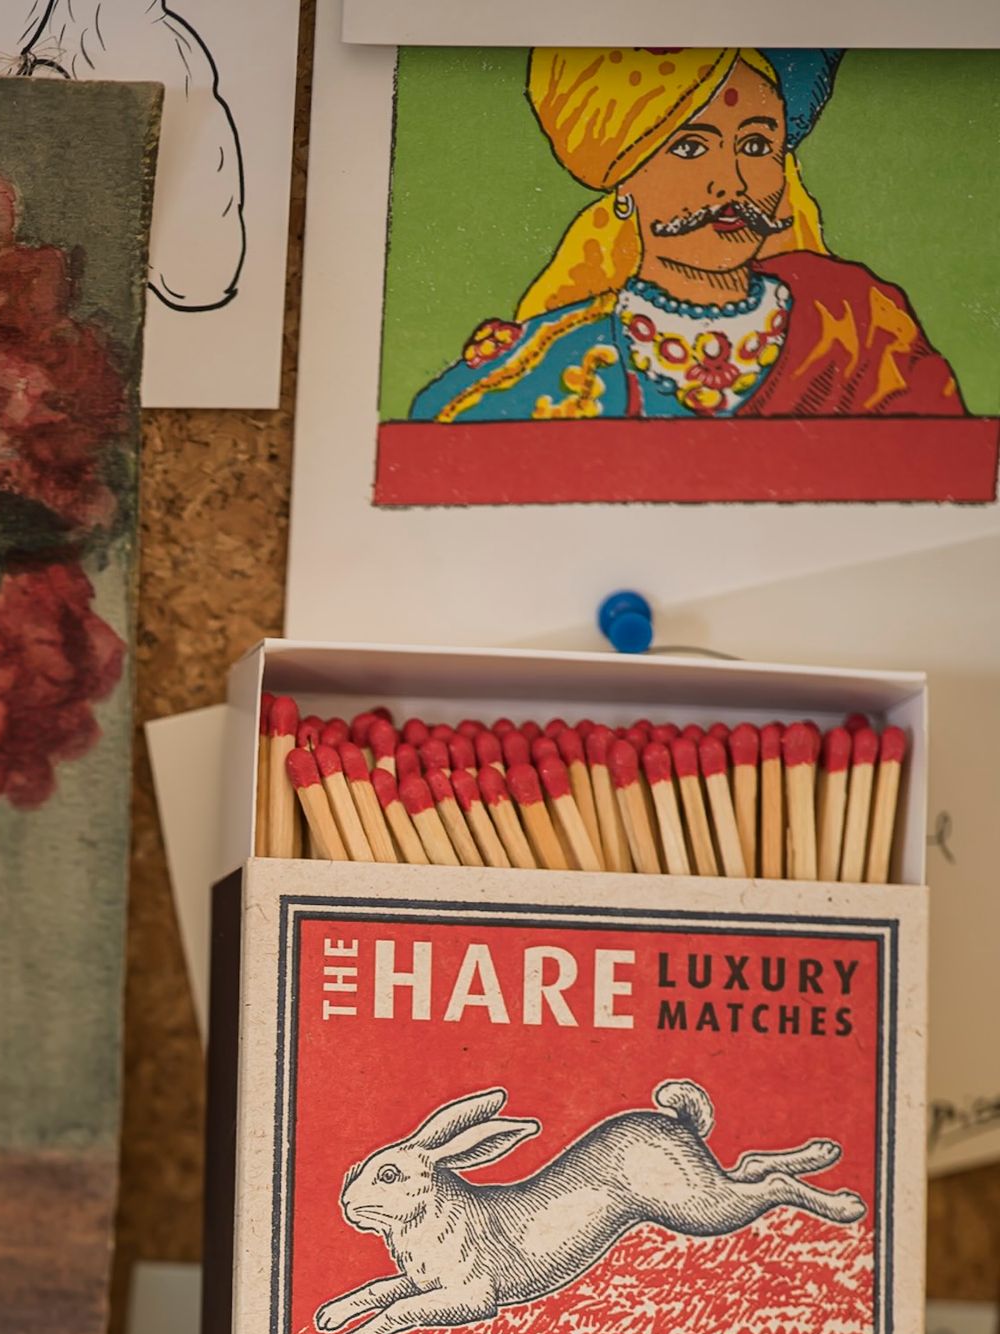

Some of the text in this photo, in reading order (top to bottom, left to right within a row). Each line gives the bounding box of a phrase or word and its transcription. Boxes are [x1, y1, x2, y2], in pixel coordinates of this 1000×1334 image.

[322, 937, 637, 1031] THE HARE
[657, 951, 861, 996] LUXURY
[656, 1000, 855, 1038] MATCHES
